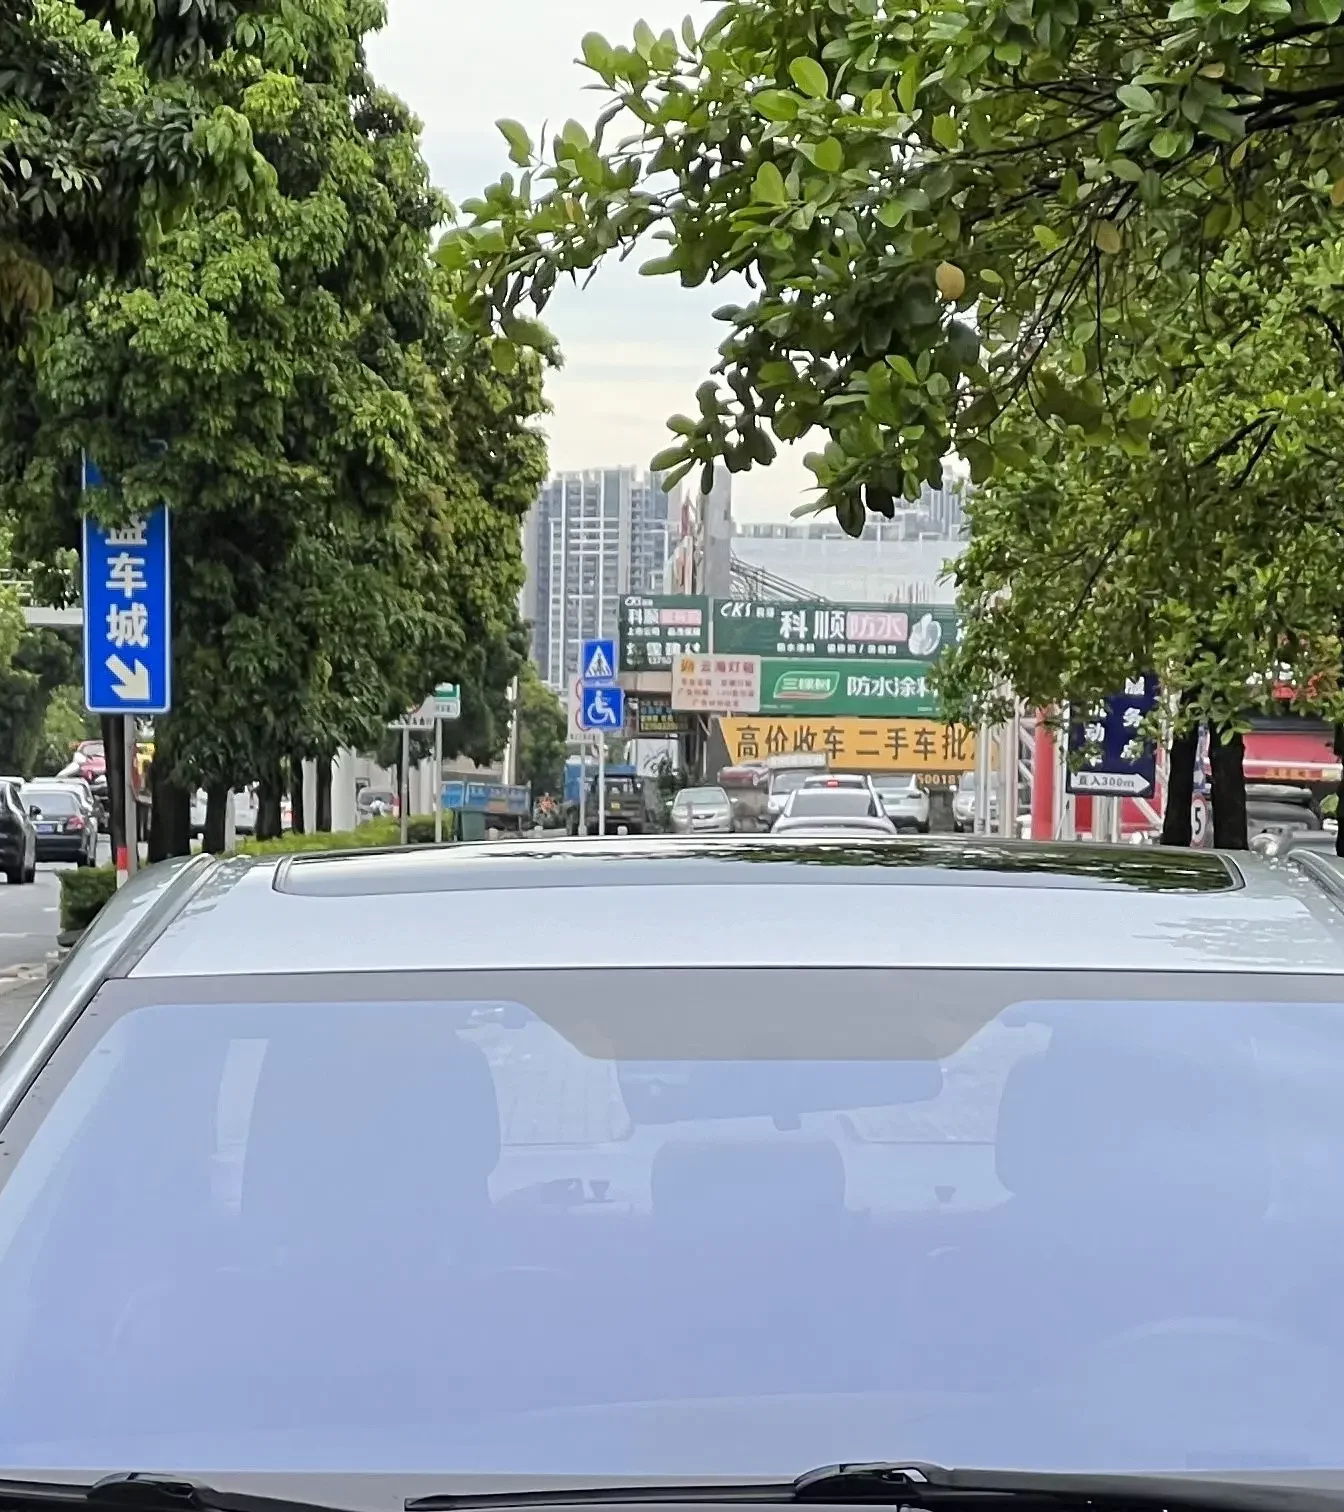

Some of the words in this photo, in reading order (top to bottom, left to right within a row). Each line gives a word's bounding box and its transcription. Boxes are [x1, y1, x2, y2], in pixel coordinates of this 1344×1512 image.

[720, 602, 752, 618] CKS
[779, 610, 903, 640] 科顺防水
[736, 724, 846, 760] 高价收车
[856, 724, 976, 762] 二手车批
